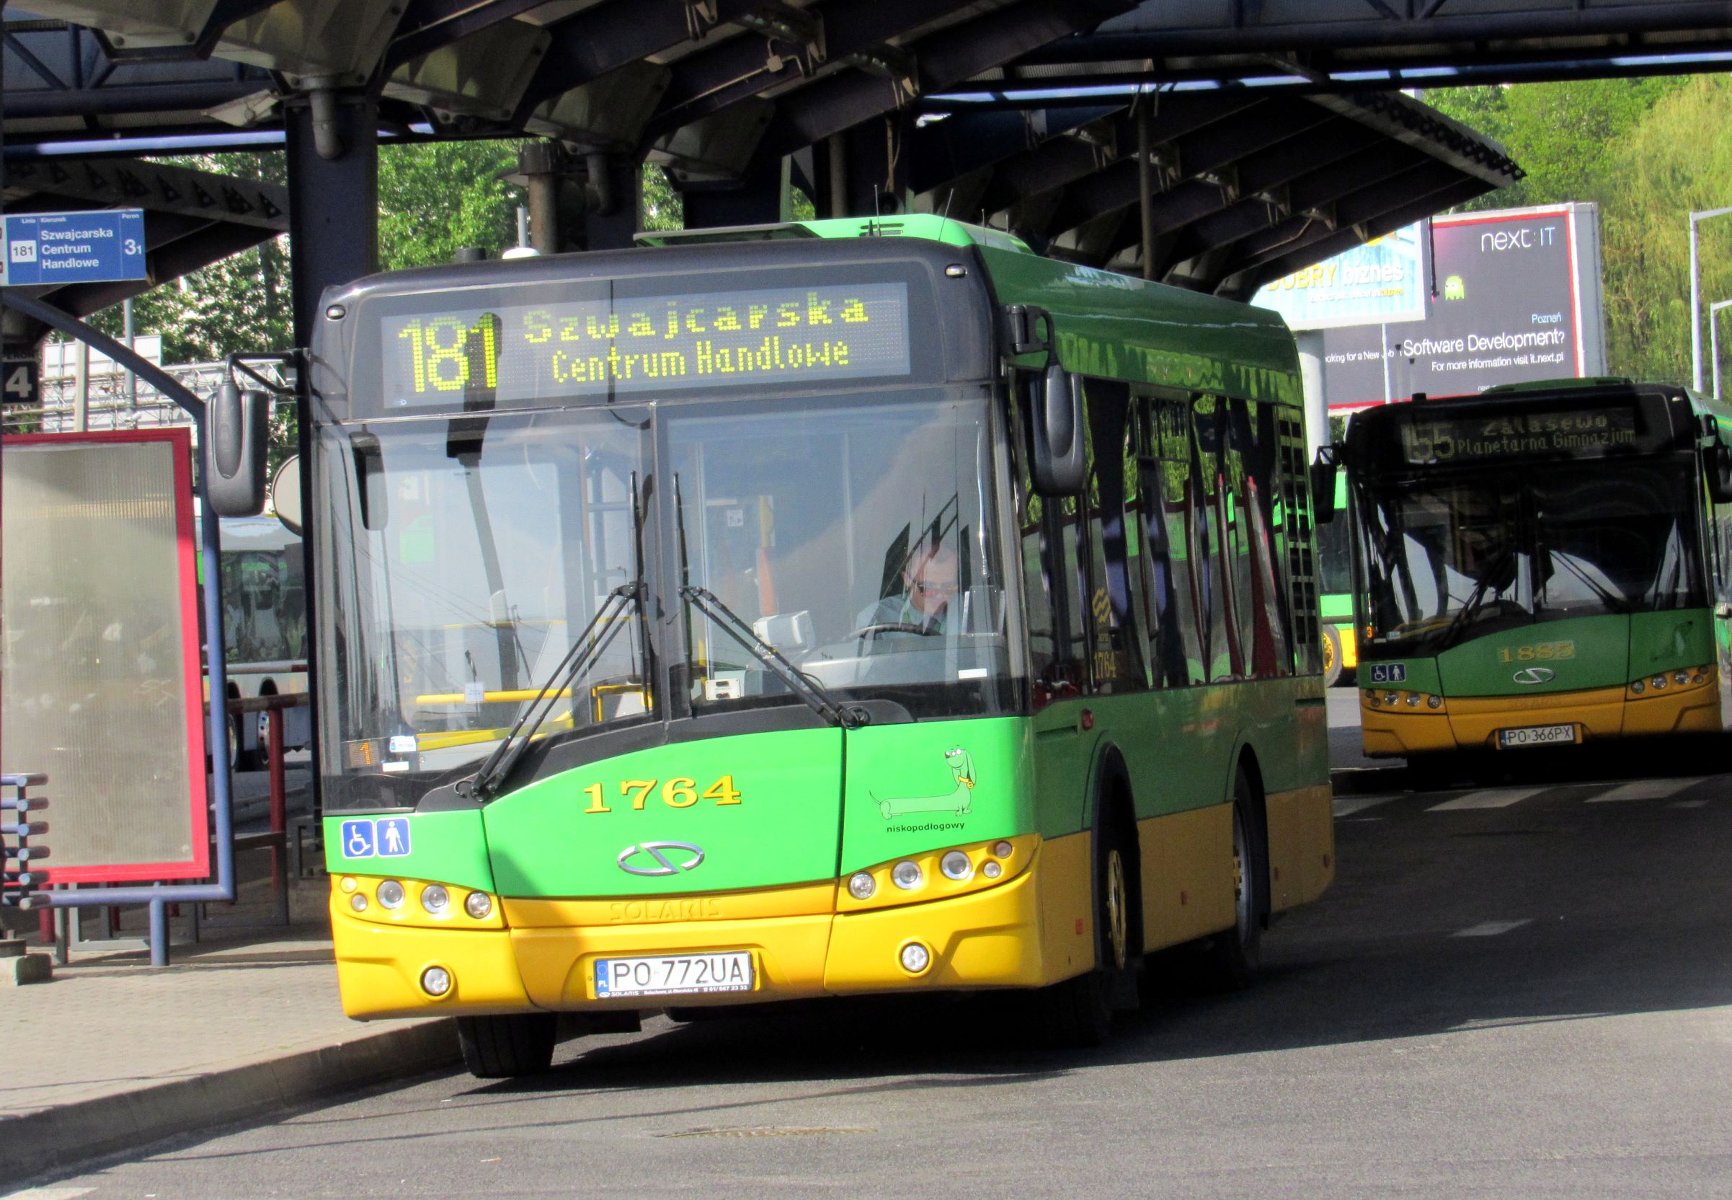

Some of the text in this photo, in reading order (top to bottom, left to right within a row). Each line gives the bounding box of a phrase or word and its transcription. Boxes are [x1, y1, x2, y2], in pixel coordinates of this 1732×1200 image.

[41, 228, 113, 242] Szwajcarska
[1540, 222, 1555, 247] IT
[13, 246, 33, 256] 181
[41, 244, 91, 255] Centrum
[42, 258, 100, 269] Handlowe
[523, 292, 869, 343] Szwajcarska
[1531, 312, 1562, 324] Poznań
[398, 312, 497, 393] 181
[1403, 337, 1464, 357] Software
[1467, 328, 1565, 352] Development?
[553, 335, 849, 383] Centrum Handlowe
[1363, 350, 1380, 360] New
[1431, 350, 1564, 372] For more information visit it.next.pl
[5, 366, 33, 398] 4
[1366, 626, 1373, 639] 3
[1507, 726, 1572, 744] PO 366PX
[359, 742, 371, 766] 1
[583, 775, 742, 814] 1764
[610, 898, 720, 921] SOLARIS
[613, 957, 744, 988] PO 772UA
[598, 980, 608, 988] PL
